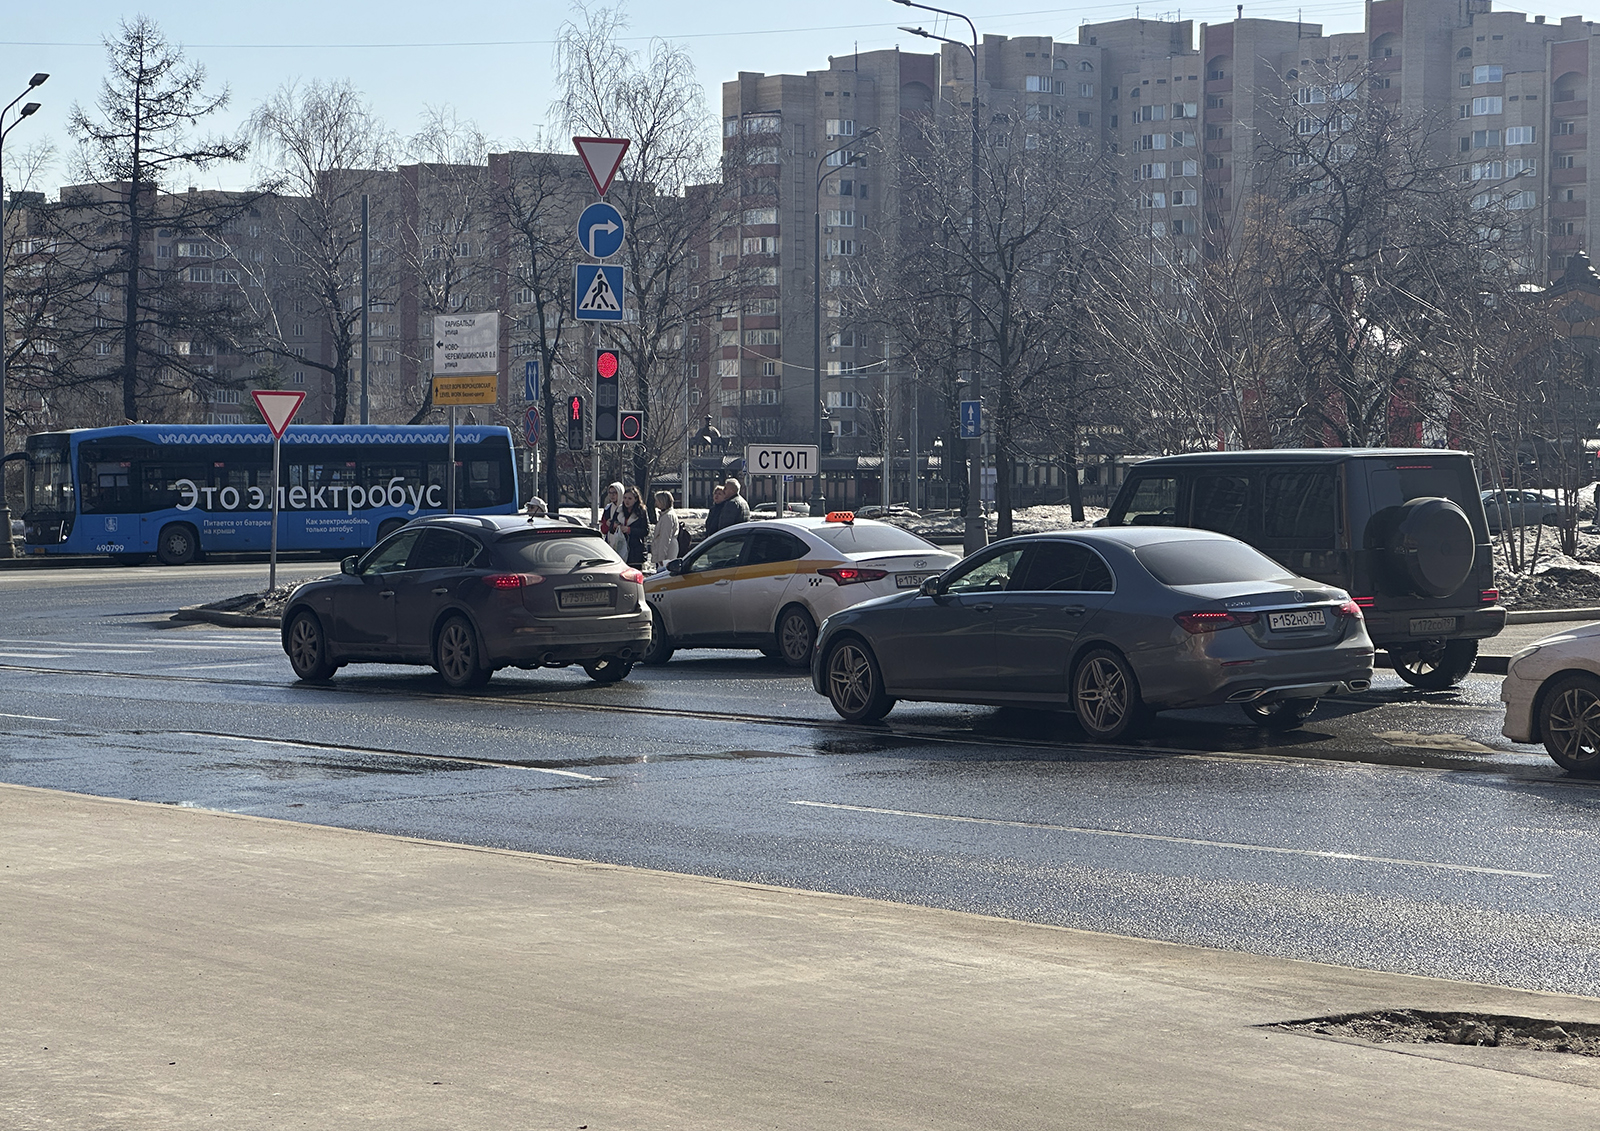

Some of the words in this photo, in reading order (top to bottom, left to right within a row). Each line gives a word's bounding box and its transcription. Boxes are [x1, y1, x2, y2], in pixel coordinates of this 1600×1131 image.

[445, 320, 475, 328] ГАРИБАЛЬДИ
[445, 329, 458, 337] улица
[444, 361, 458, 369] улица
[759, 450, 808, 470] СТОП
[175, 479, 240, 511] Это
[248, 475, 442, 516] электробус
[204, 519, 234, 527] Питается
[319, 517, 370, 526] электромобиль,
[213, 528, 236, 536] крыше
[328, 525, 354, 533] автобус
[96, 544, 125, 552] 490799
